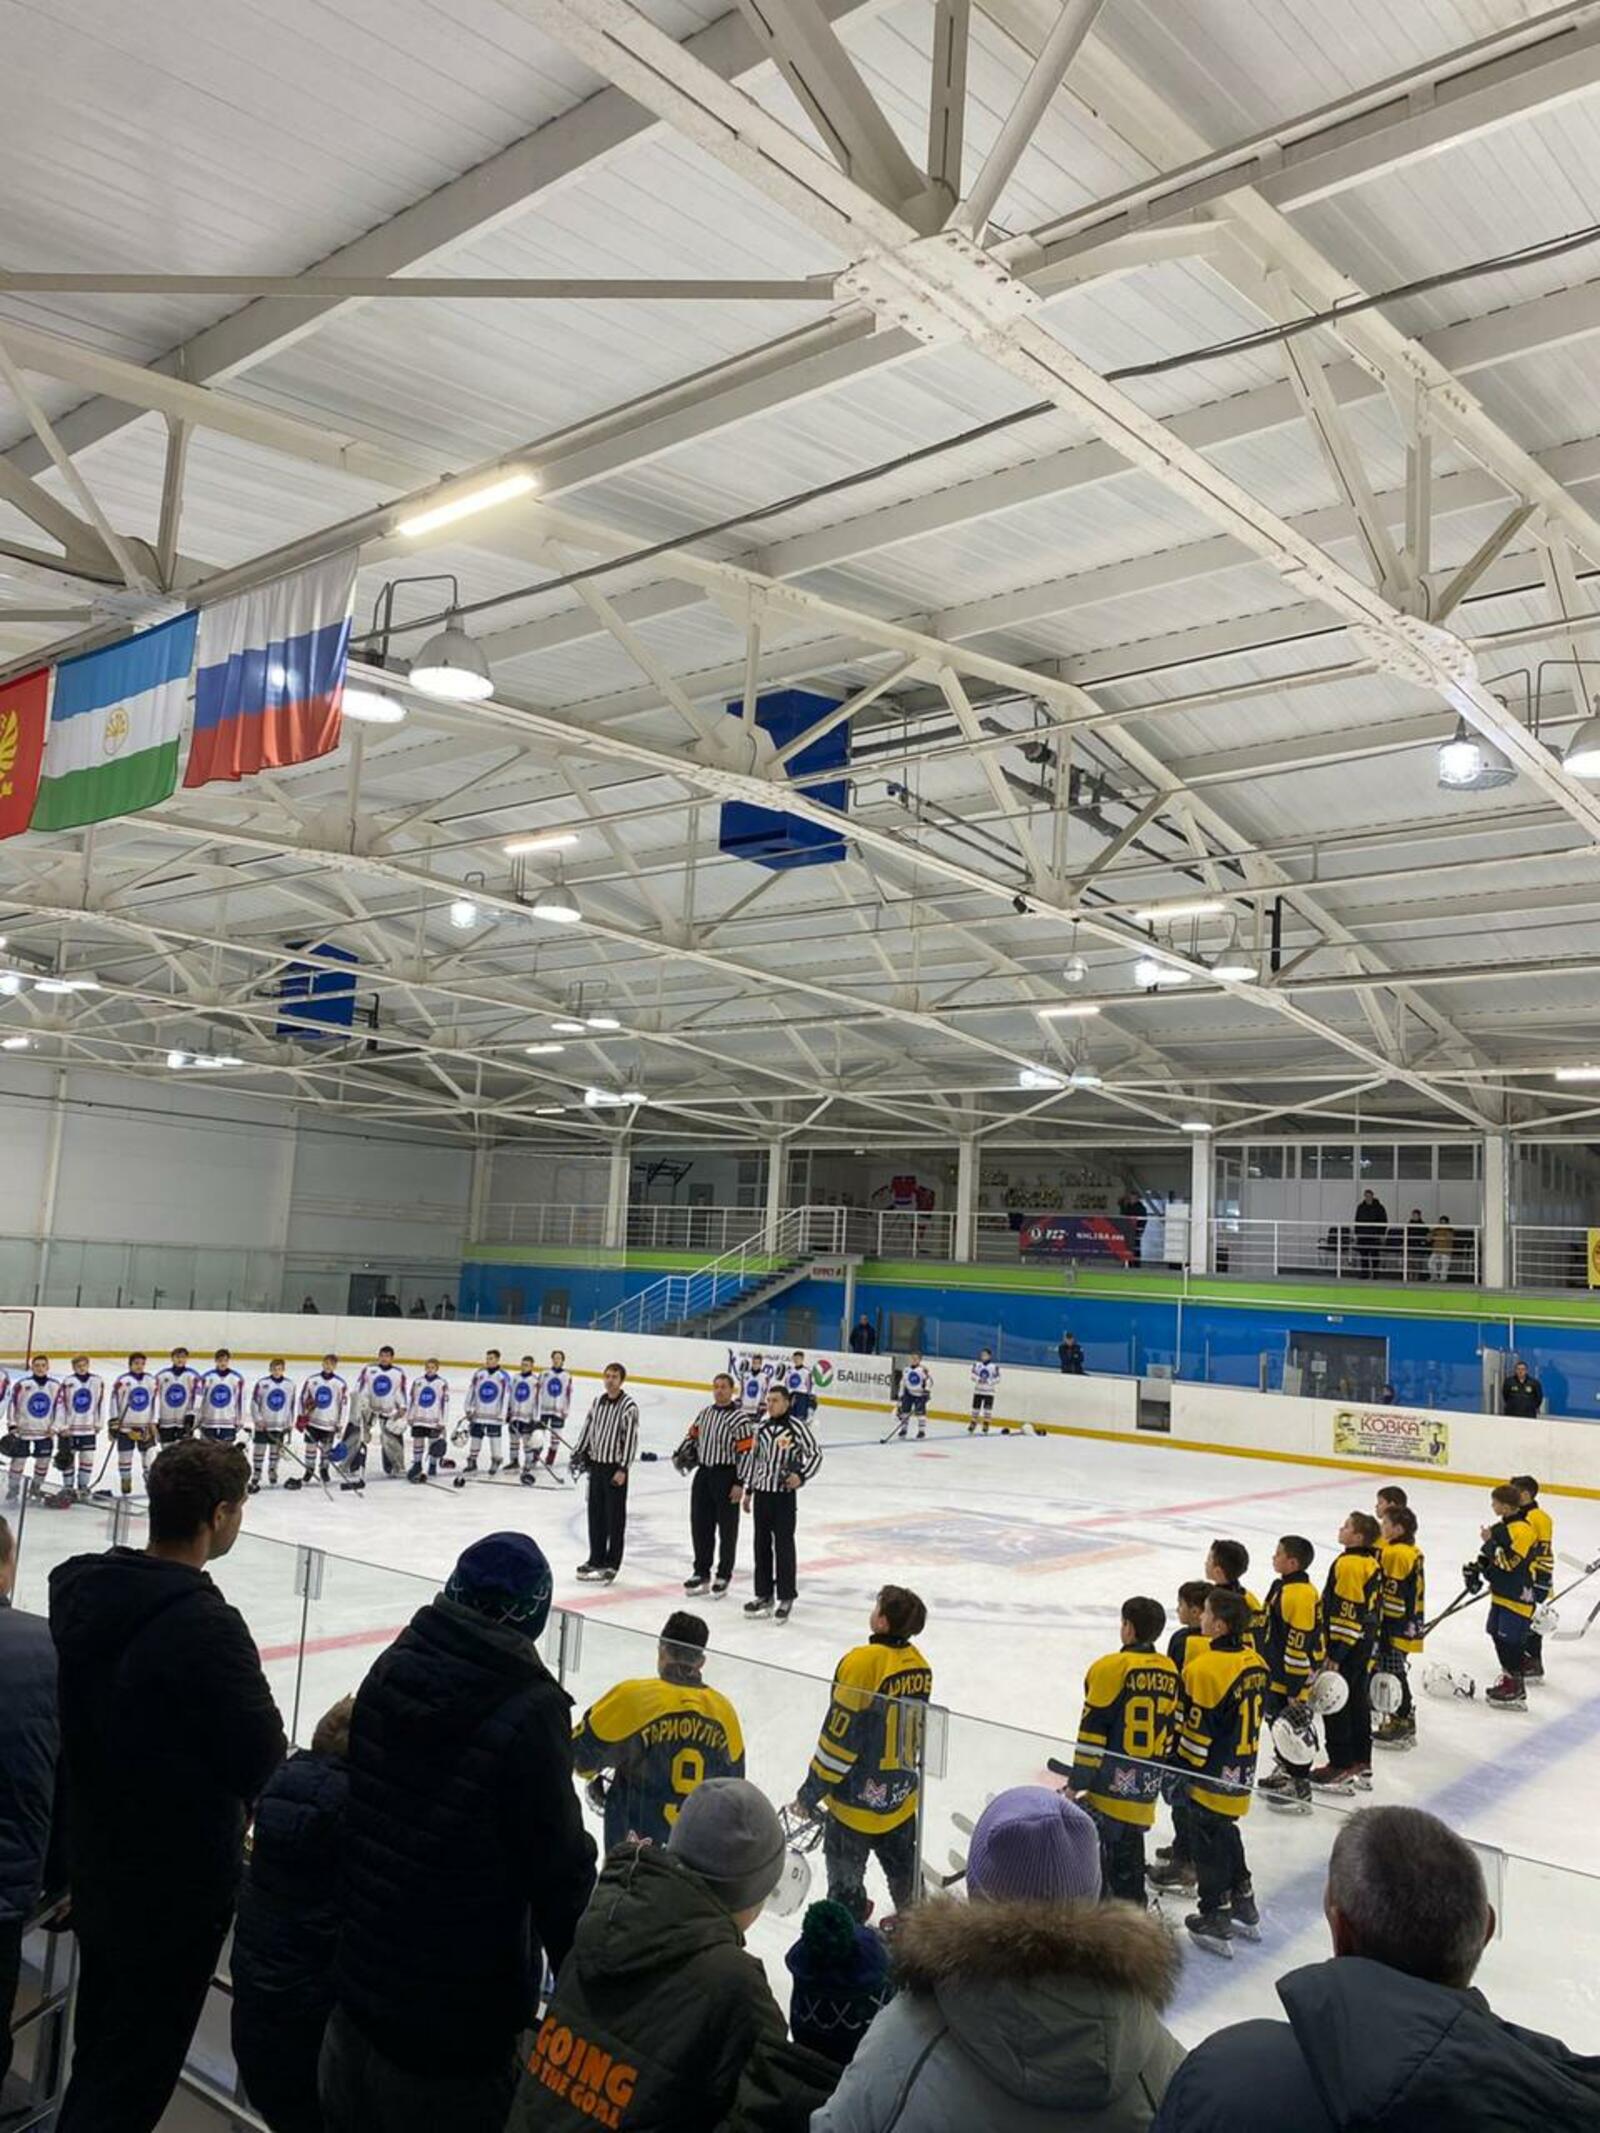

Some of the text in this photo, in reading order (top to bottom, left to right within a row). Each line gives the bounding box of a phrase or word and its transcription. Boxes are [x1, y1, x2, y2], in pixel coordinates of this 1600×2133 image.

[1360, 1416, 1420, 1436] КОВКА
[1340, 1601, 1357, 1620] 90
[1287, 1629, 1305, 1649] 50
[828, 1708, 850, 1739] 10
[536, 2016, 639, 2108] GOING
